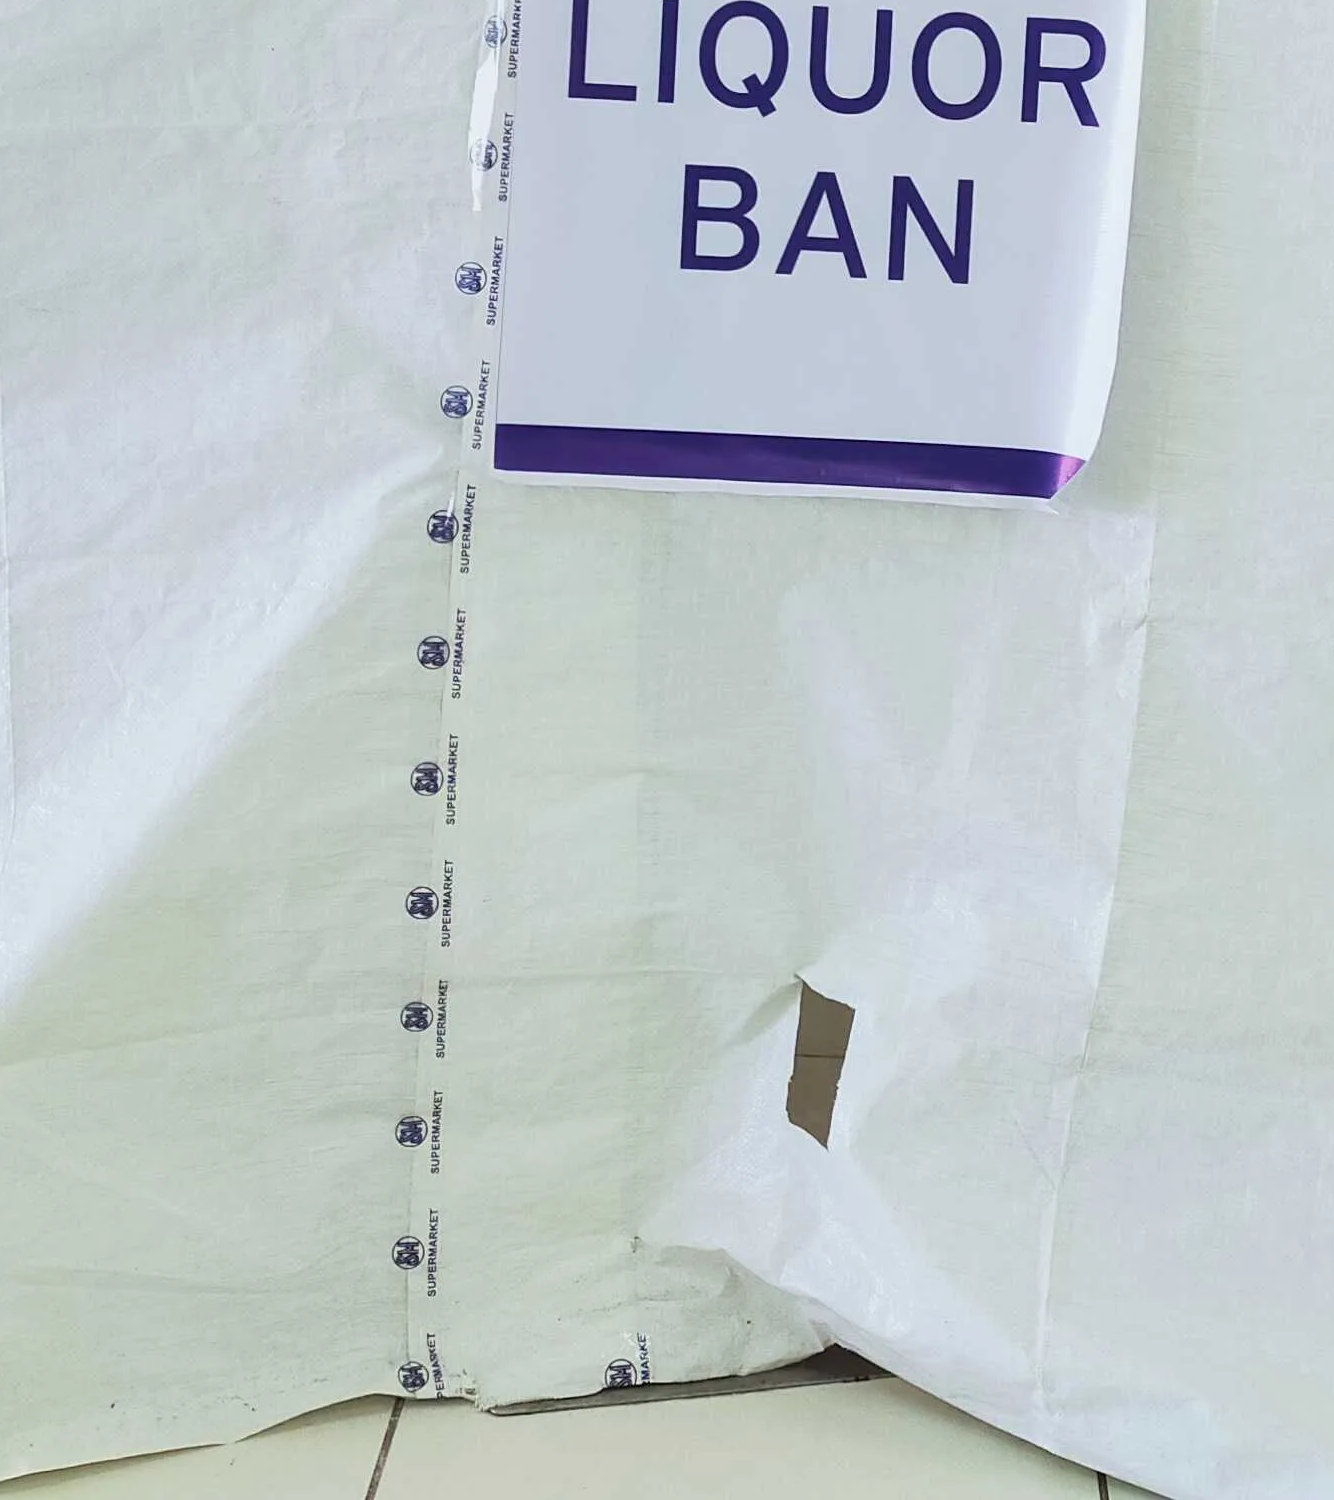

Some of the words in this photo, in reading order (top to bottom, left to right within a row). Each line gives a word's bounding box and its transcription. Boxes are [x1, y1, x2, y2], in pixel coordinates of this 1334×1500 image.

[498, 112, 515, 203] SUPERMARKET
[678, 162, 976, 285] BAN
[486, 235, 504, 326] SUPERMARKET
[472, 360, 491, 450] SUPERMARKET
[460, 484, 477, 575] SUPERMARKET
[451, 608, 467, 699] SUPERMARKET
[445, 734, 459, 825] SUPERMARKET
[441, 859, 454, 948] SUPERMARKET
[435, 979, 450, 1059] SUPERMARKET
[430, 1090, 444, 1174] SUPERMARKET
[427, 1208, 440, 1297] SUPERMARKET
[426, 1332, 445, 1398] PERMARKET
